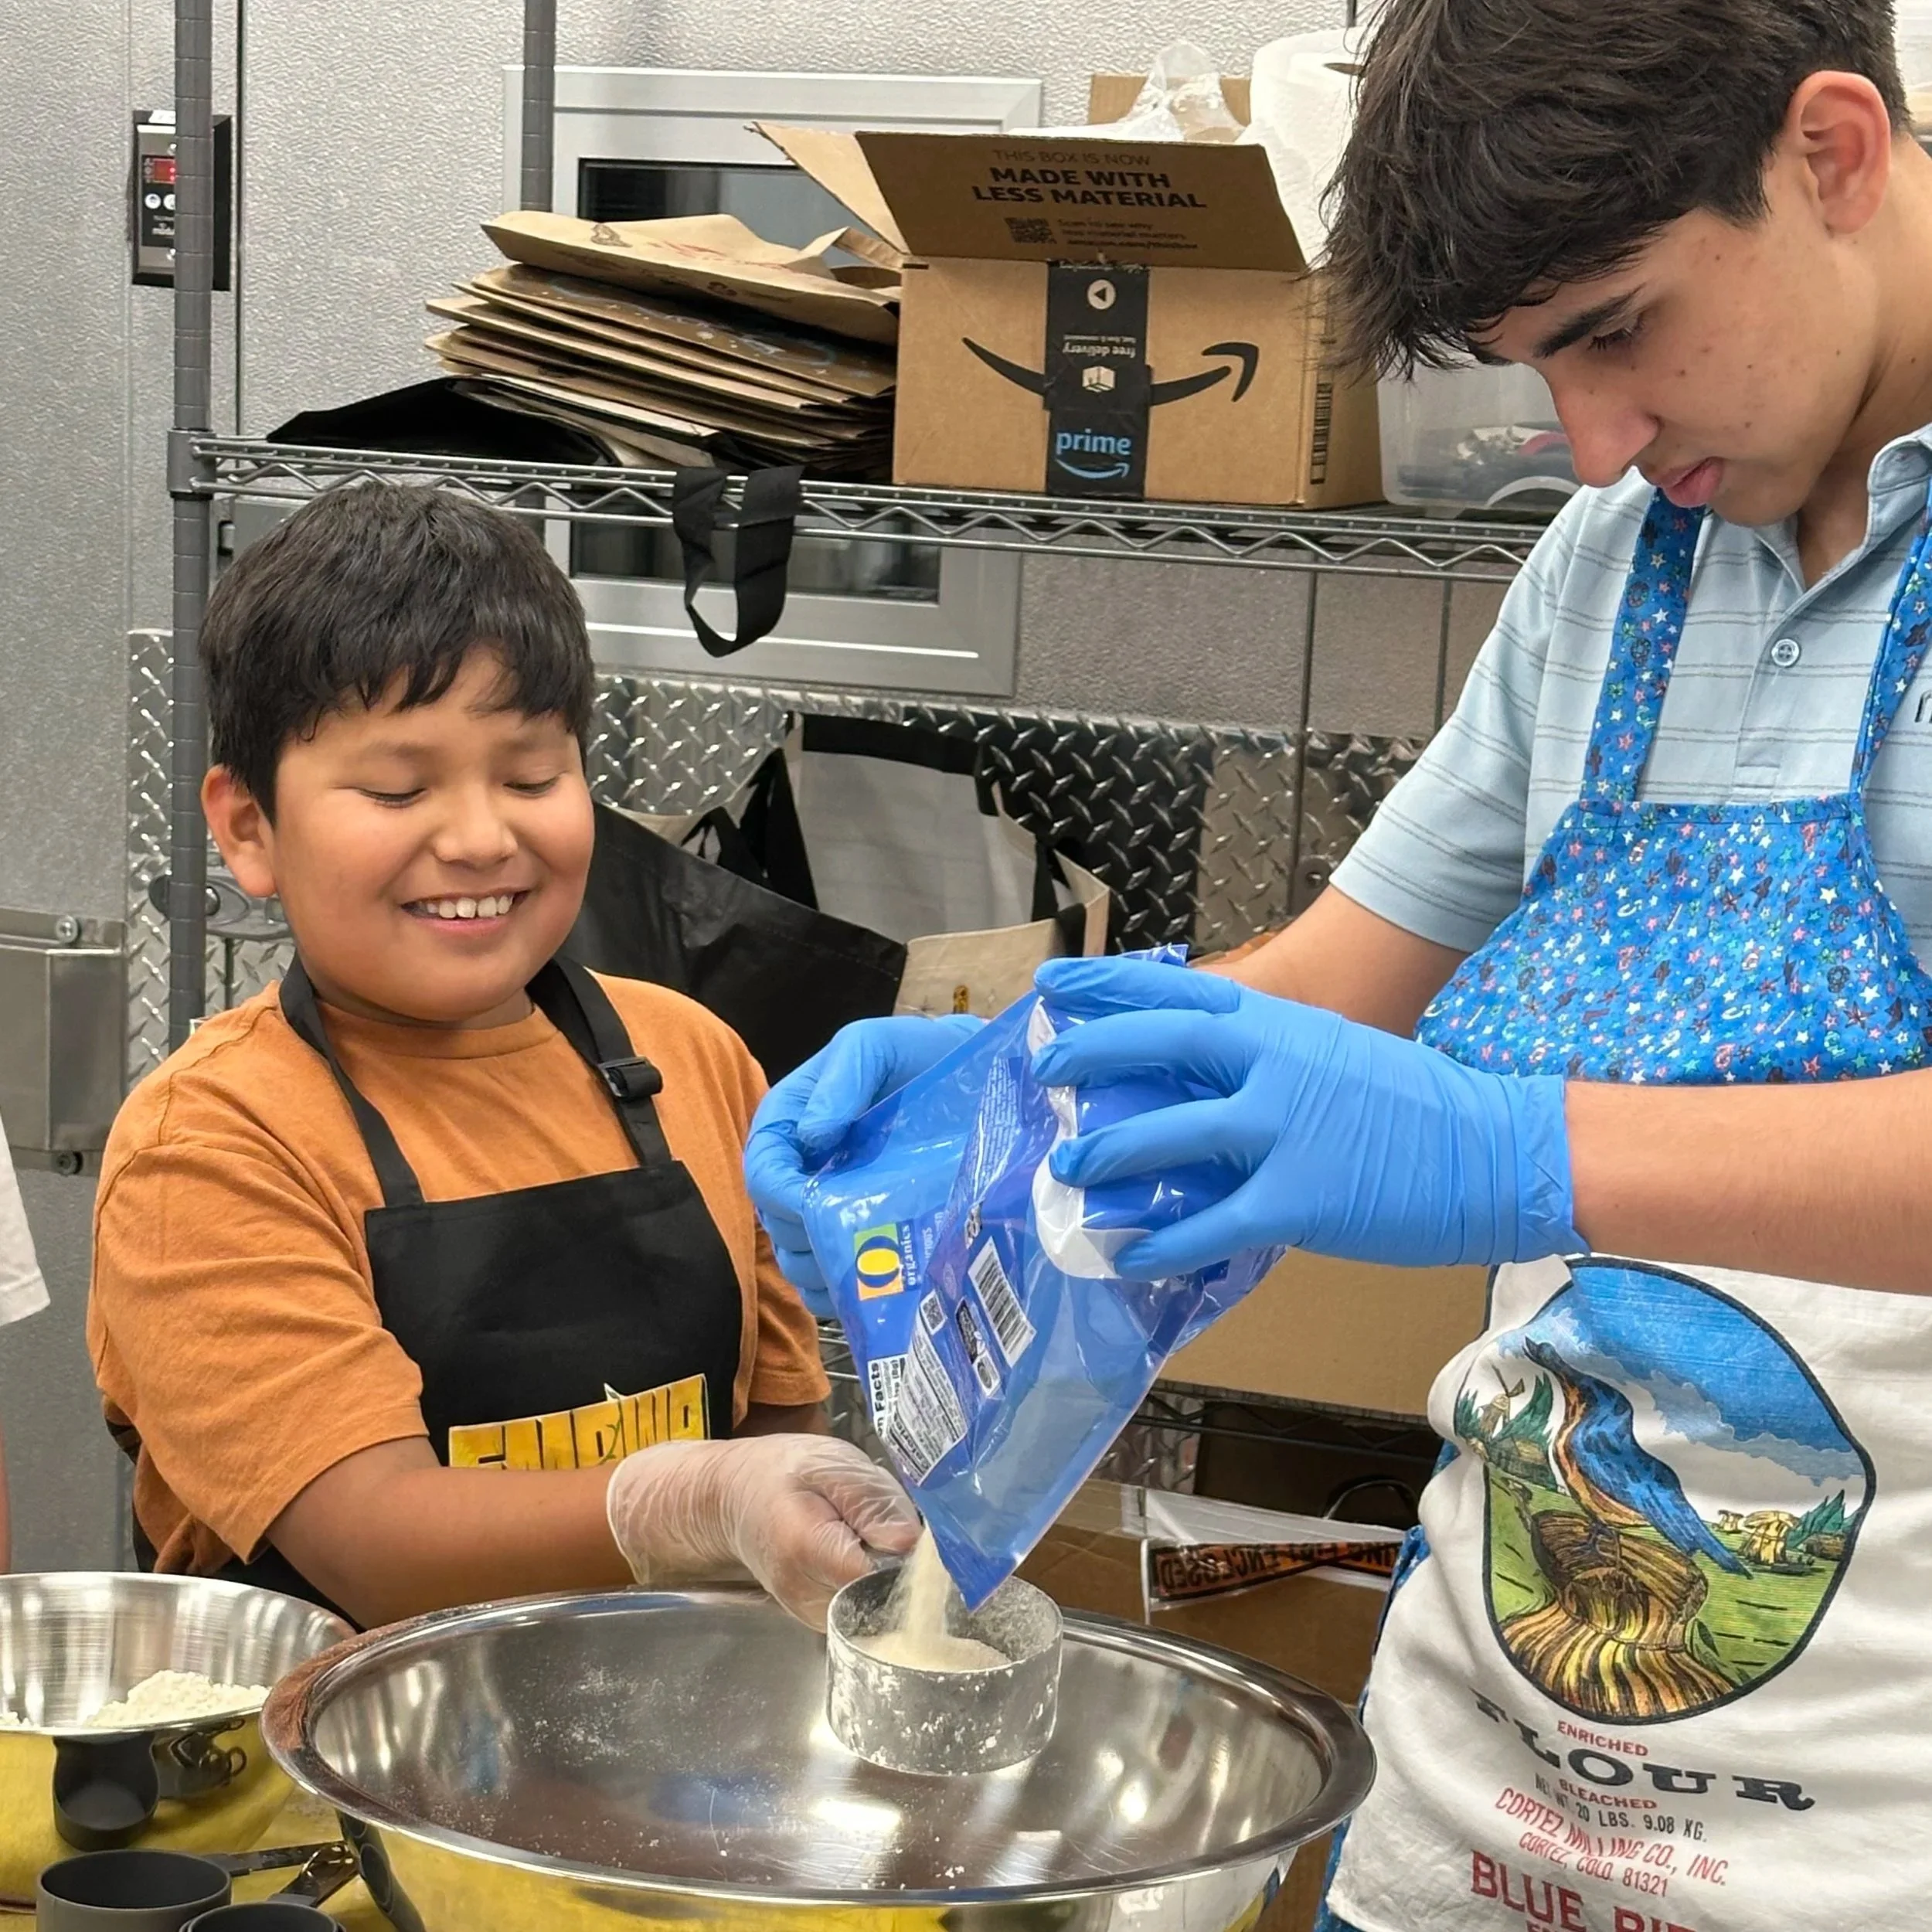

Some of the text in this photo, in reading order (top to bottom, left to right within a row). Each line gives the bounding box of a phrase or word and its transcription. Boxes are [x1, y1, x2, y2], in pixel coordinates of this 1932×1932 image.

[992, 150, 1151, 166] THIS BOX IS NOW
[989, 166, 1171, 189] MADE WITH
[971, 185, 1208, 208] LESS MATERIAL
[1062, 342, 1136, 359] free delivery
[1056, 428, 1131, 456] prime
[900, 1224, 918, 1287] organics
[871, 1362, 886, 1413] Facts
[1468, 1687, 1816, 1811] FLOUR
[1557, 1720, 1649, 1757] ENRICHED
[1559, 1778, 1658, 1810] BLEACHED
[1576, 1801, 1590, 1822] 20
[1598, 1810, 1635, 1828] LBS.
[1643, 1814, 1675, 1835] 9.08
[1495, 1787, 1564, 1838] CORTEZ
[1642, 1843, 1678, 1876] CO.,
[1685, 1854, 1729, 1886] INC.
[1471, 1849, 1587, 1932] BLUE
[1623, 1867, 1668, 1898] 81321
